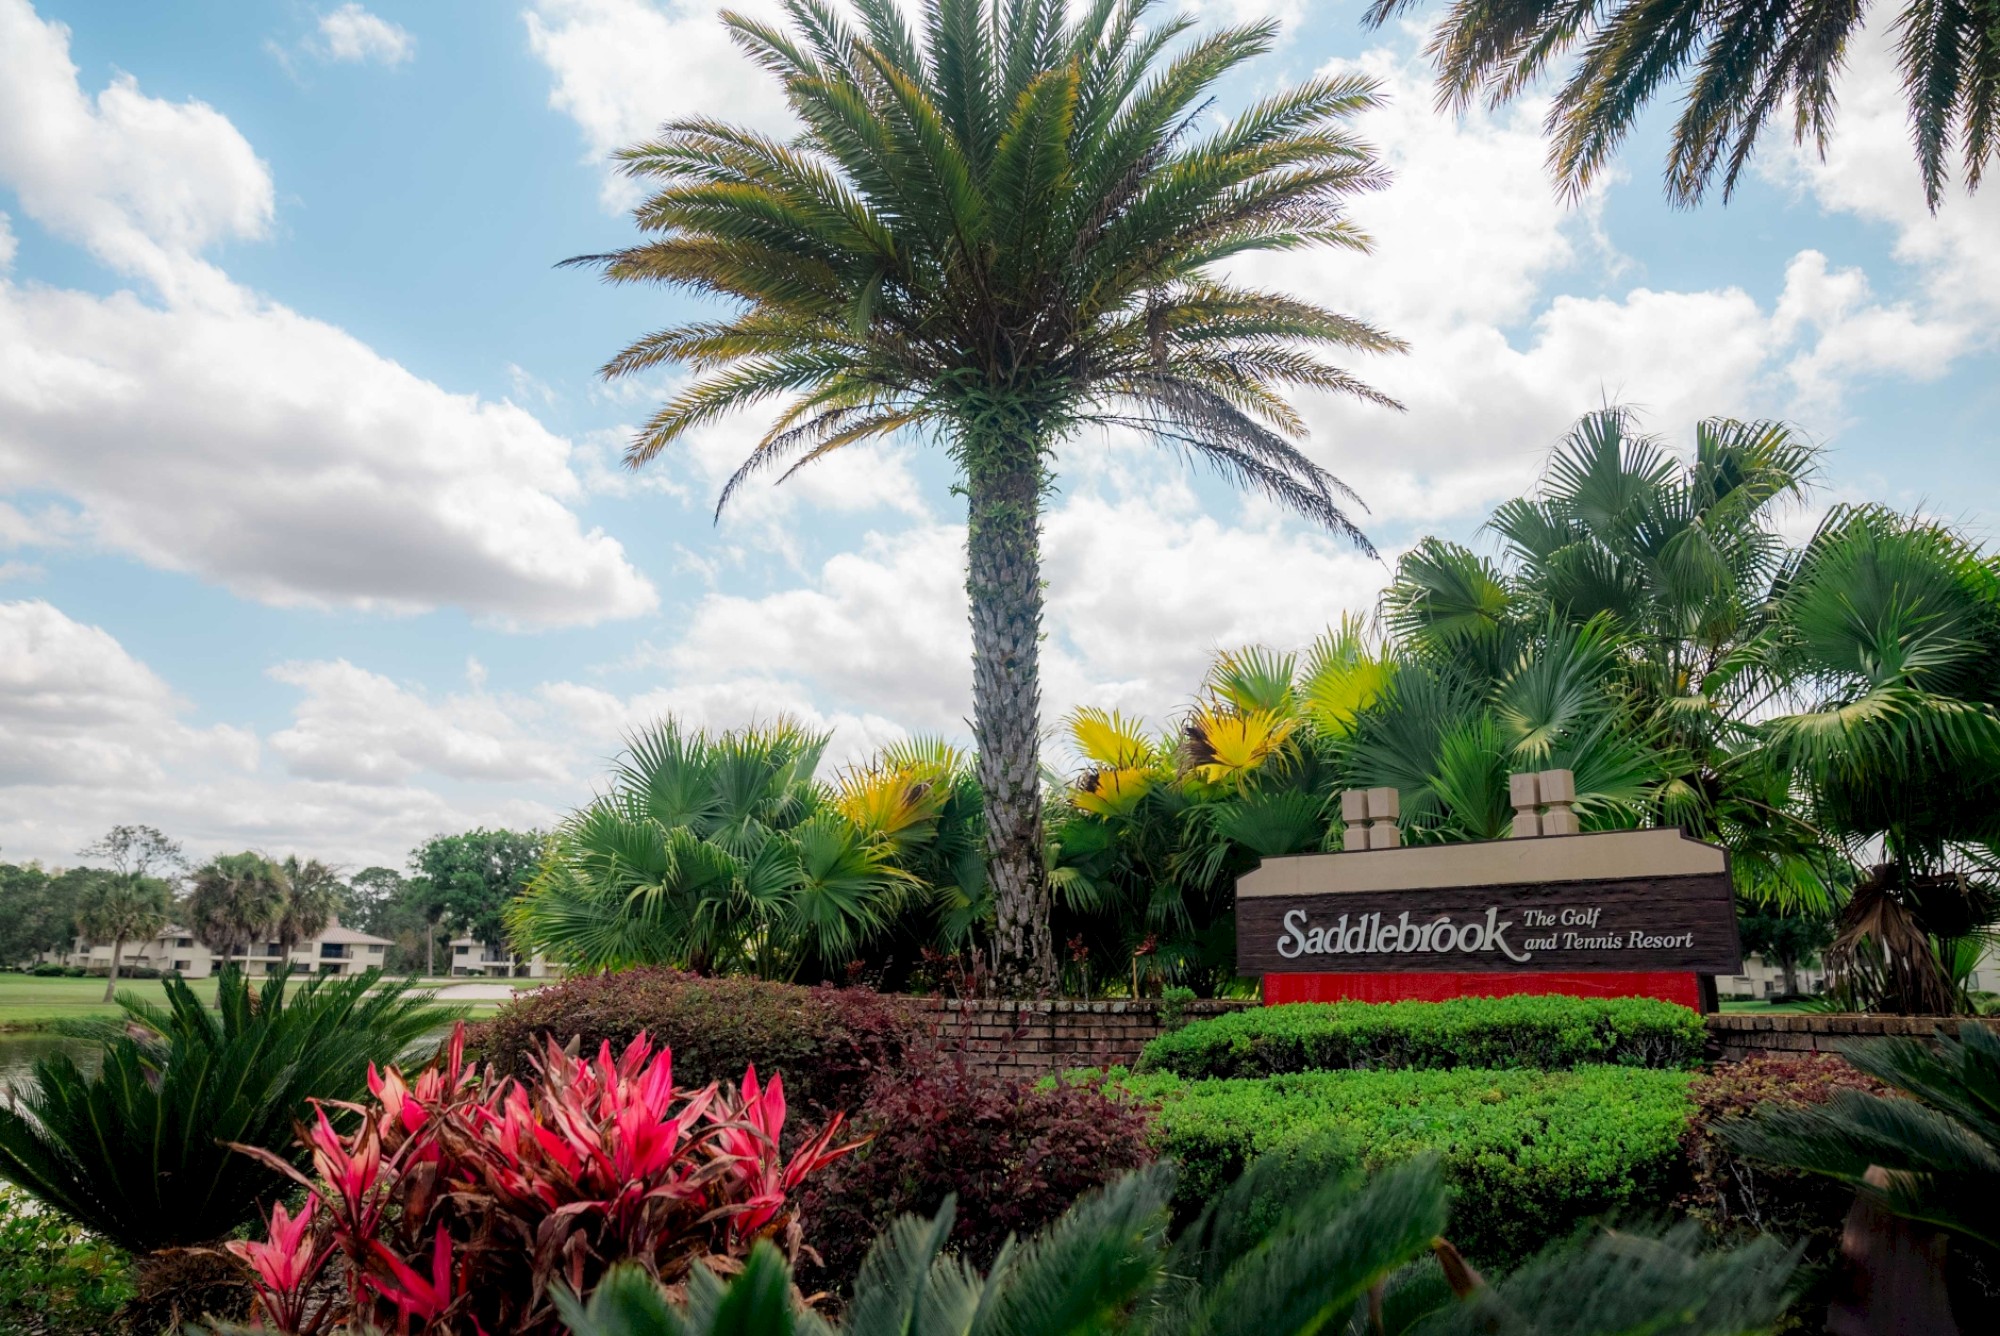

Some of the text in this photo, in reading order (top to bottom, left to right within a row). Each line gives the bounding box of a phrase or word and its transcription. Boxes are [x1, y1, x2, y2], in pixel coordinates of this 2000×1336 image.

[1523, 907, 1602, 929] The Golf
[1277, 907, 1532, 962] Saddlebrook
[1524, 930, 1695, 951] and Tennis Resort
